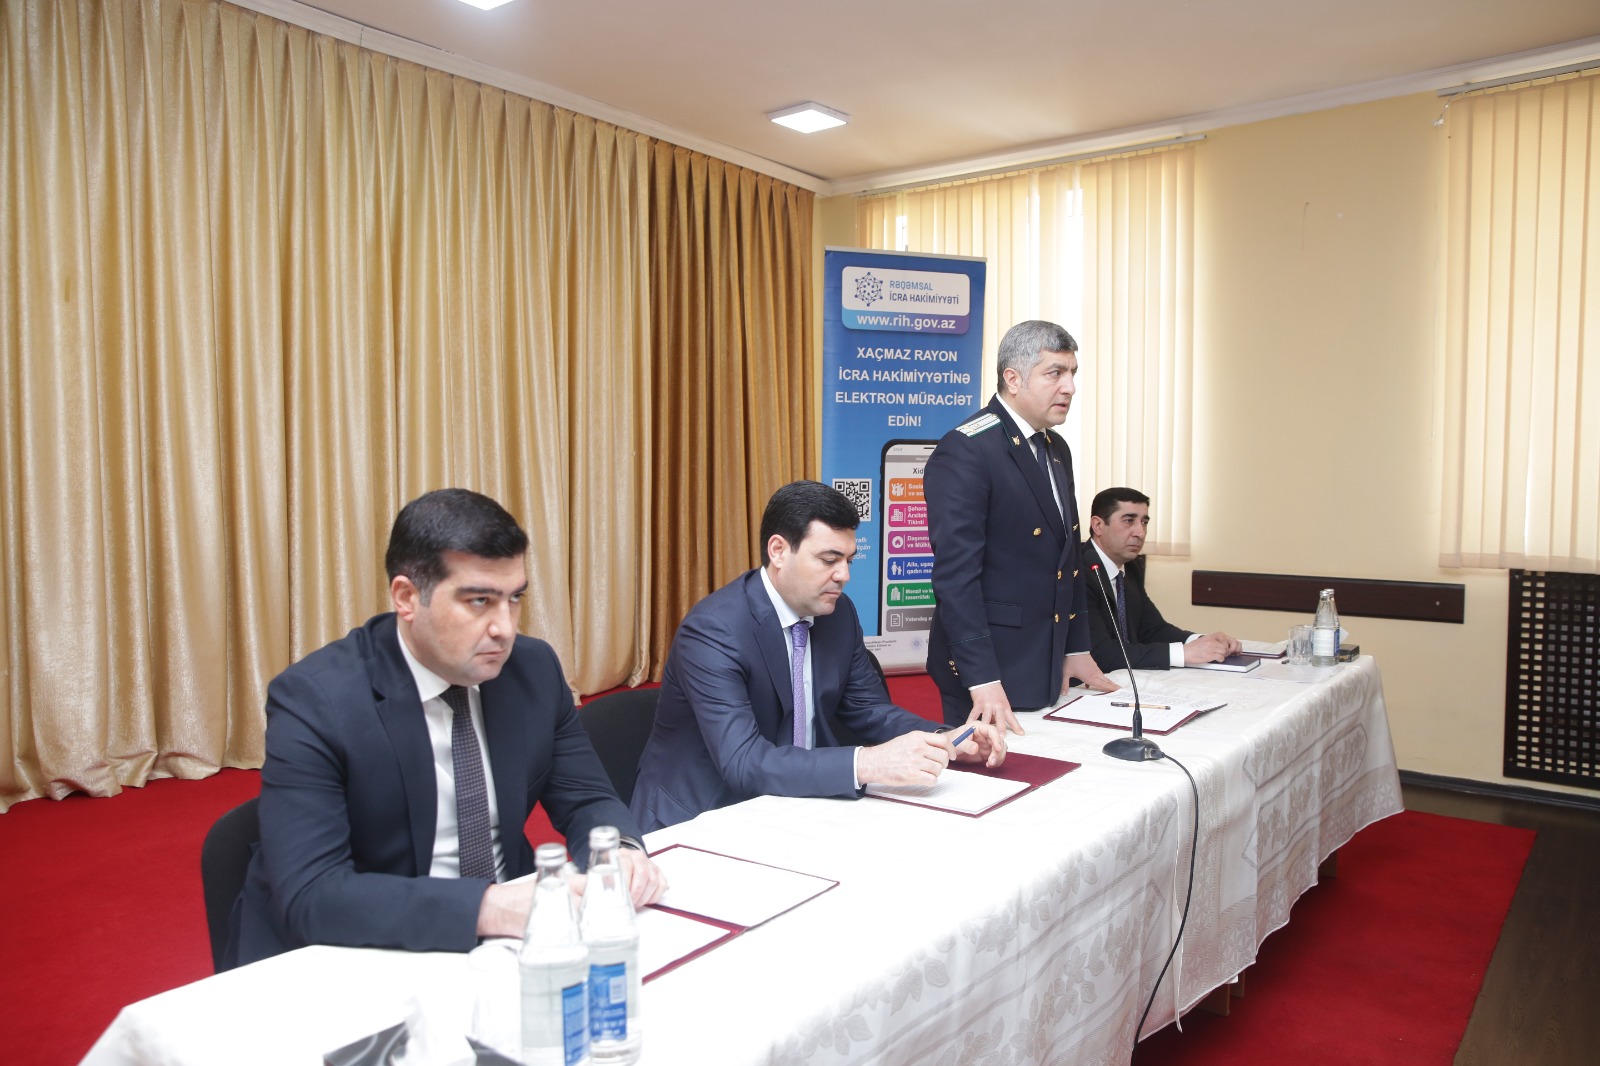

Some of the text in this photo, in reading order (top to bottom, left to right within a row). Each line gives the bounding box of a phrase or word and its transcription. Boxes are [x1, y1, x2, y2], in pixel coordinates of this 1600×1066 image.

[890, 280, 934, 291] RƏQƏMSAL
[890, 292, 959, 304] İCRA HAKİMİYYƏTİ
[857, 314, 956, 330] www.rih.gov.az
[857, 348, 958, 362] XAÇMAZ RAYON
[839, 366, 970, 384] İCRA HAKİMİYYƏTİNƏ
[836, 392, 973, 406] ELEKTRON MÜRACİƏT
[888, 413, 921, 427] EDİN!
